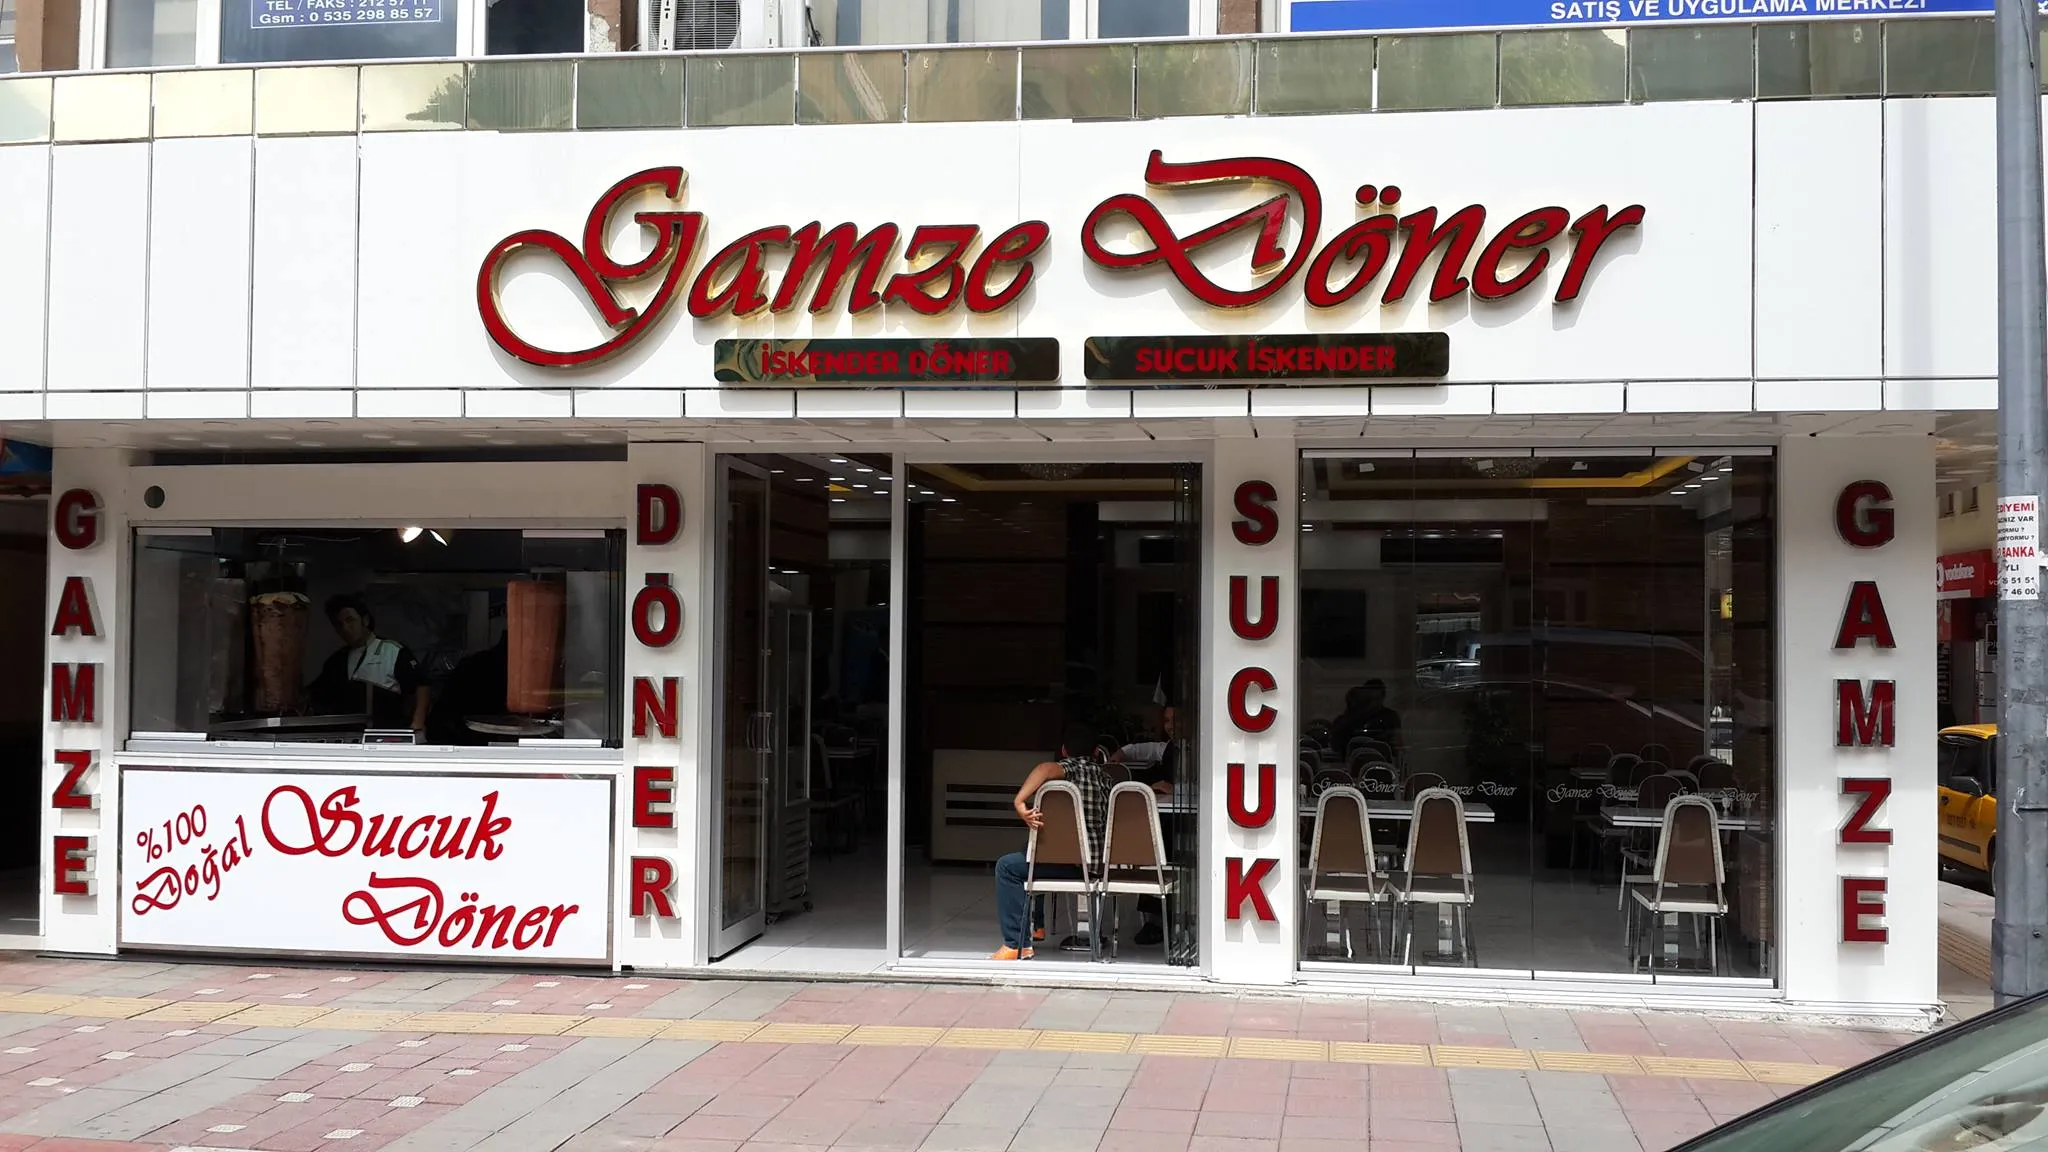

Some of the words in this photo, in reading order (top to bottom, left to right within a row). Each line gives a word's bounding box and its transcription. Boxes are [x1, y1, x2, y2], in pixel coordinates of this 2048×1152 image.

[259, 13, 294, 24] Gsm
[309, 12, 319, 22] 0
[323, 11, 351, 21] 535
[356, 10, 385, 20] 298
[390, 9, 409, 19] 85
[414, 8, 433, 18] 57
[266, 1, 293, 11] TEL
[307, 0, 345, 9] FAKS
[359, 0, 385, 8] 212
[1550, 0, 1621, 22] SATIŞ
[1629, 0, 1659, 17] VE
[1668, 0, 1808, 16] UYGULAMA
[478, 166, 1049, 368] Gamze
[1082, 150, 1645, 310] Döner
[761, 344, 901, 376] İSKENDER
[907, 342, 1012, 376] DÖNER
[1135, 345, 1240, 375] SUCUK
[1246, 339, 1397, 374] İSKENDER
[51, 487, 103, 896] GAMZE
[630, 483, 684, 920] DÖNER
[1226, 481, 1279, 922] SUCUK
[1836, 481, 1896, 943] GAMZE
[261, 784, 512, 861] Sucuk
[1477, 781, 1517, 796] Döner
[1547, 783, 1593, 803] Gamze
[132, 814, 252, 916] Doğal
[136, 804, 207, 863] %100
[342, 871, 579, 951] Döner
